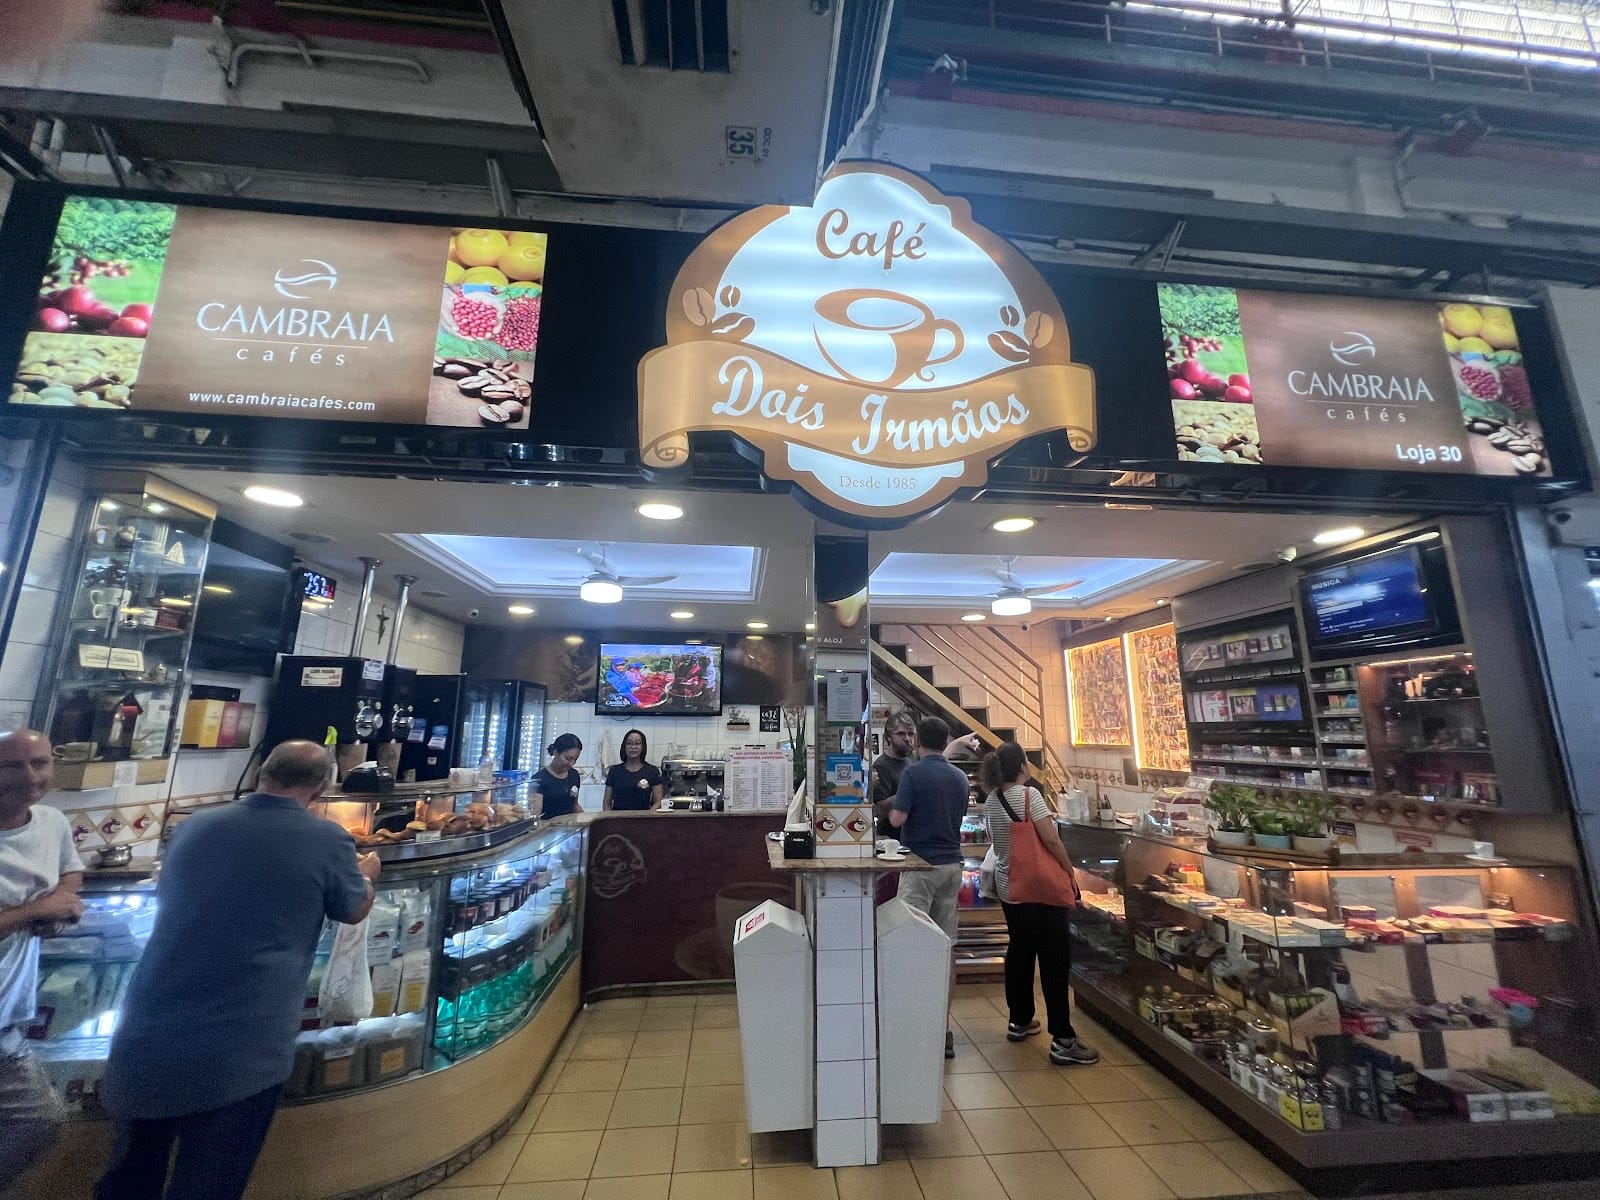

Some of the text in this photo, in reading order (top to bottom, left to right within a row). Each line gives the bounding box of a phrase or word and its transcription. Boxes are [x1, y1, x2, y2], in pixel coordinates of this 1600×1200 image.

[728, 130, 755, 156] 35
[815, 208, 927, 270] Café
[196, 302, 395, 343] CAMBRAIA
[235, 346, 346, 367] cafés
[1288, 370, 1434, 403] CAMBRAIA
[188, 391, 376, 411] www.cambraiacafes.com
[711, 354, 1029, 454] Dois Irmãos
[1326, 406, 1407, 424] cafés
[1396, 443, 1463, 464] Loja 30
[839, 474, 917, 491] Desde 1985
